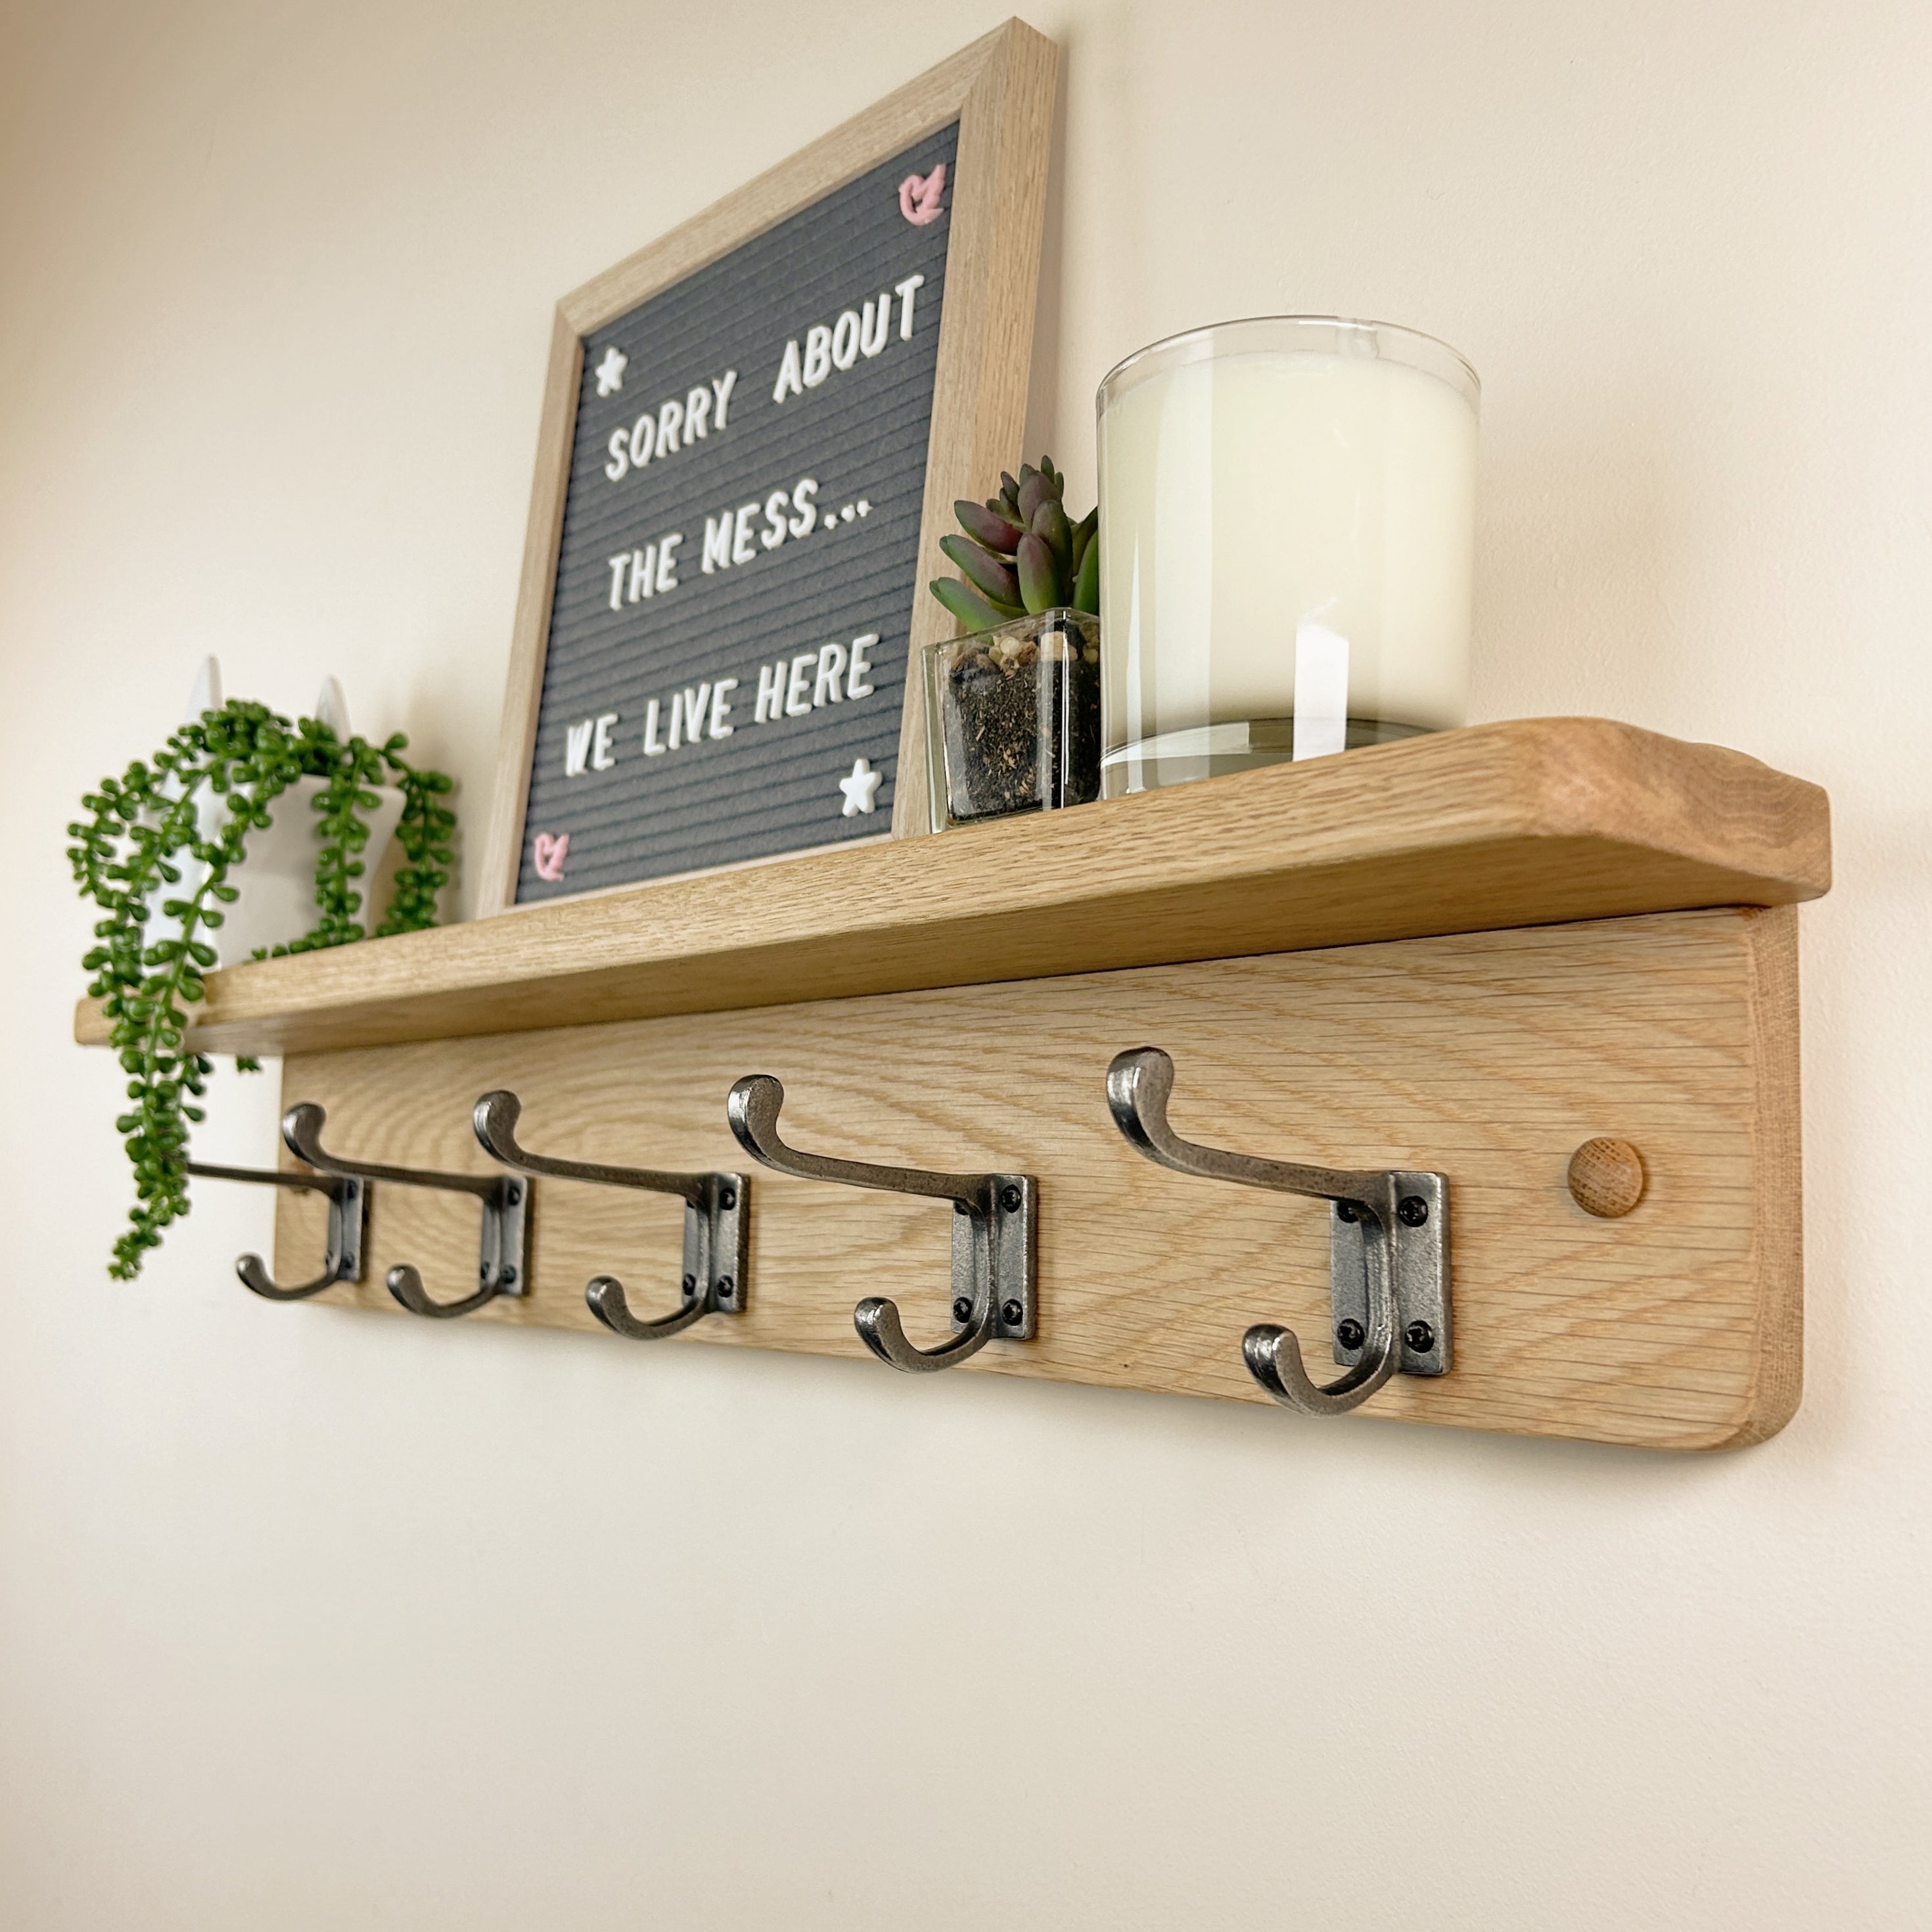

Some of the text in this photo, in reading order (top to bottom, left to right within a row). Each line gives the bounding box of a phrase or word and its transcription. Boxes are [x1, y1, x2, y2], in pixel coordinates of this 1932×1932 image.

[604, 274, 925, 482] SORRY ABOUT
[607, 478, 873, 611] THE MESS...
[564, 633, 879, 778] WE LIVE HERE
